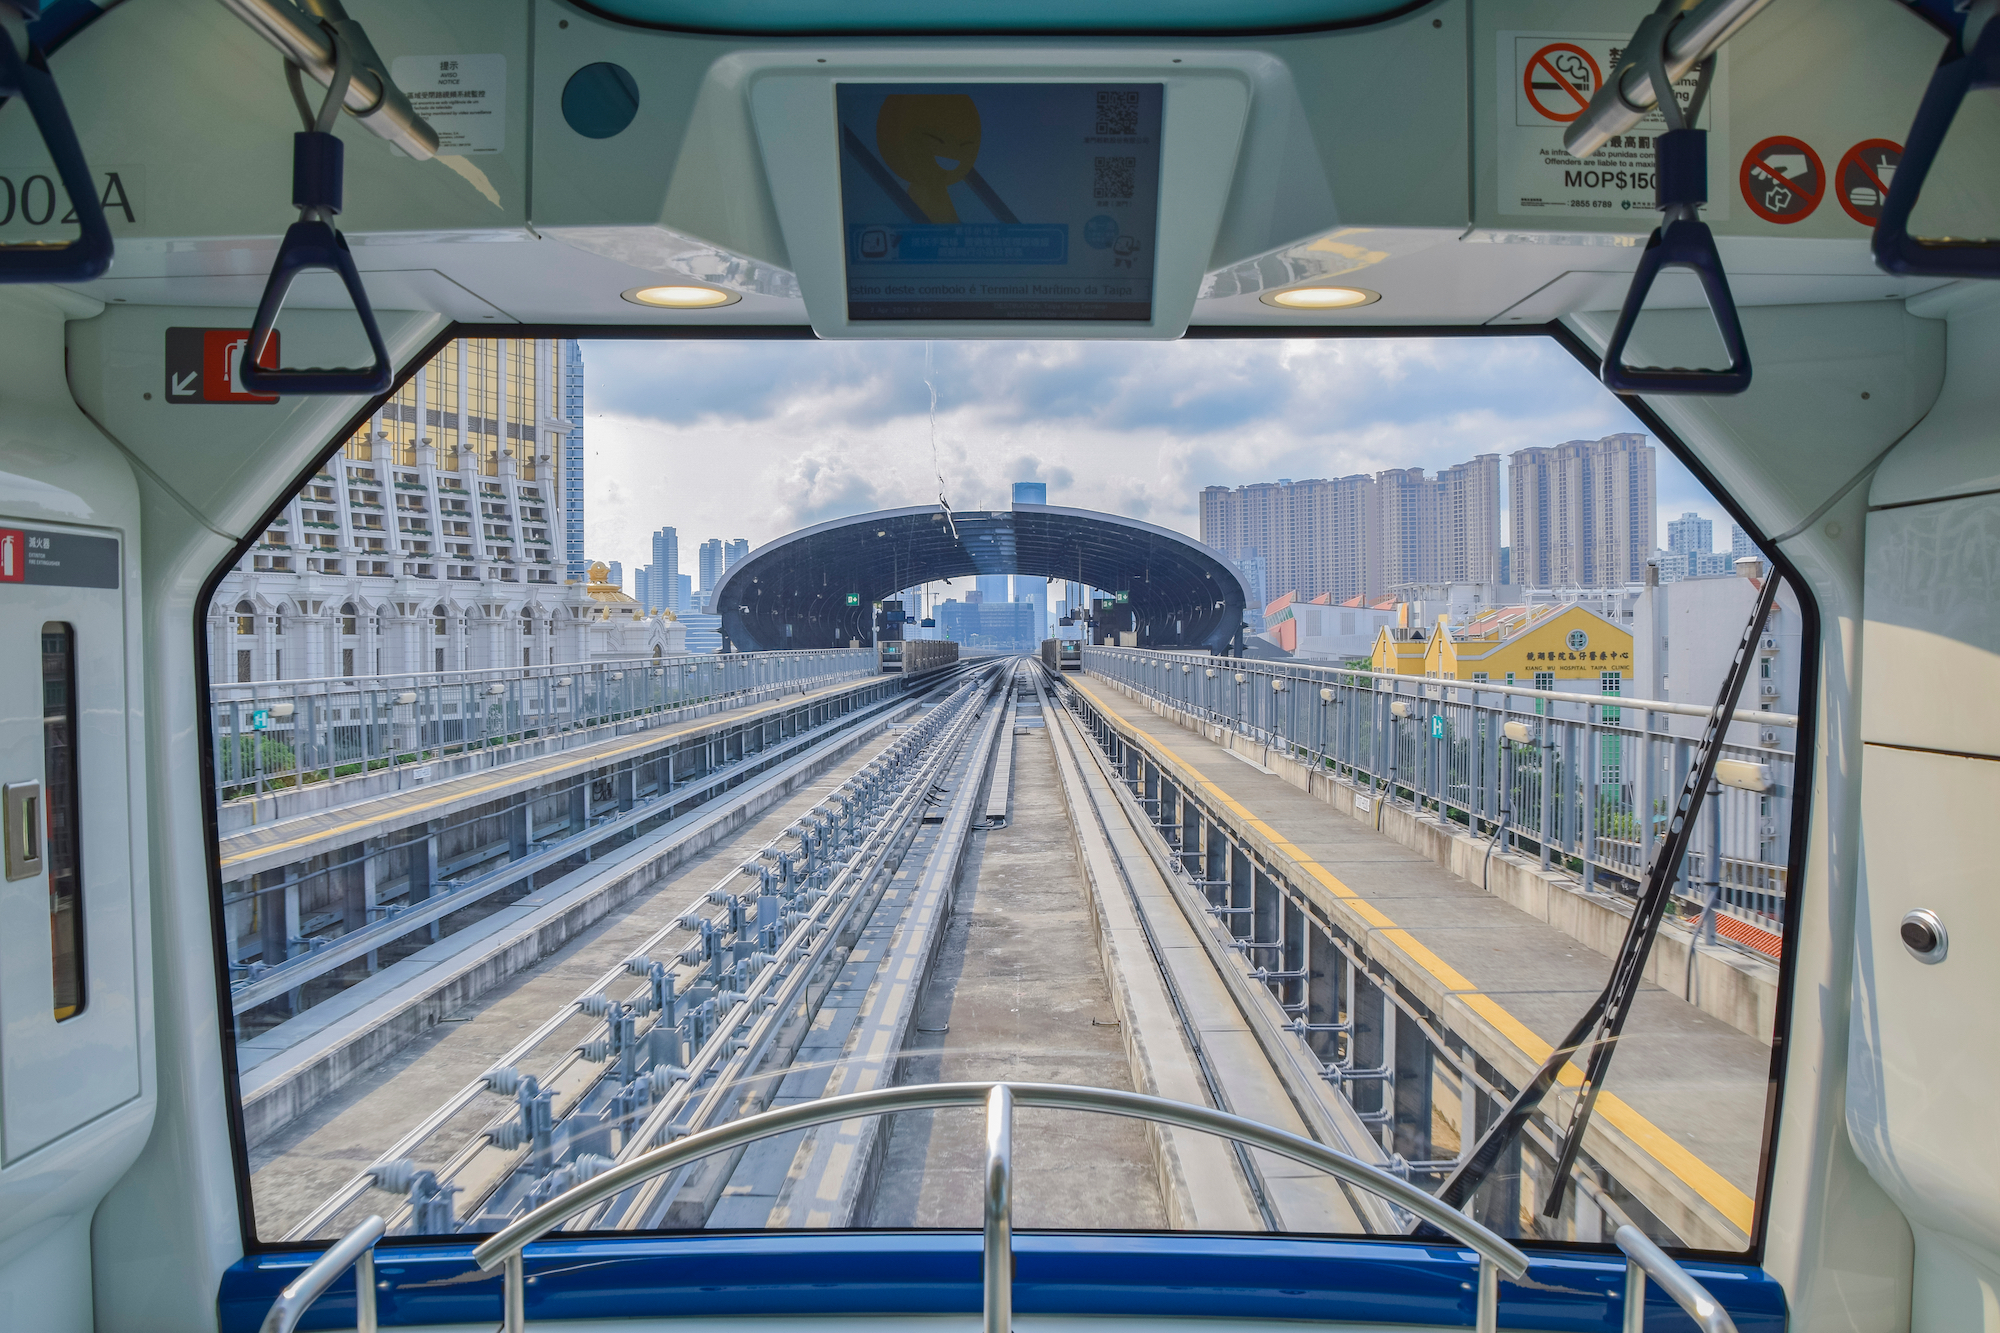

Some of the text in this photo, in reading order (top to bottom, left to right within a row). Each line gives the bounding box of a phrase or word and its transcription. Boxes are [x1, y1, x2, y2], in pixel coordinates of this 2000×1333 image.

[440, 61, 459, 71] 提示
[1540, 148, 1550, 156] As
[1608, 151, 1637, 159] punidas
[1544, 157, 1582, 166] Offenders
[1597, 159, 1618, 167] liable
[1592, 200, 1612, 208] 6789
[885, 284, 915, 295] deste
[918, 284, 966, 295] comboio
[969, 283, 976, 295] é
[980, 284, 1028, 295] Terminal
[1032, 283, 1081, 295] Marítimo
[1084, 284, 1098, 295] da
[1103, 284, 1132, 297] Taipa
[29, 536, 51, 549] 滅火器
